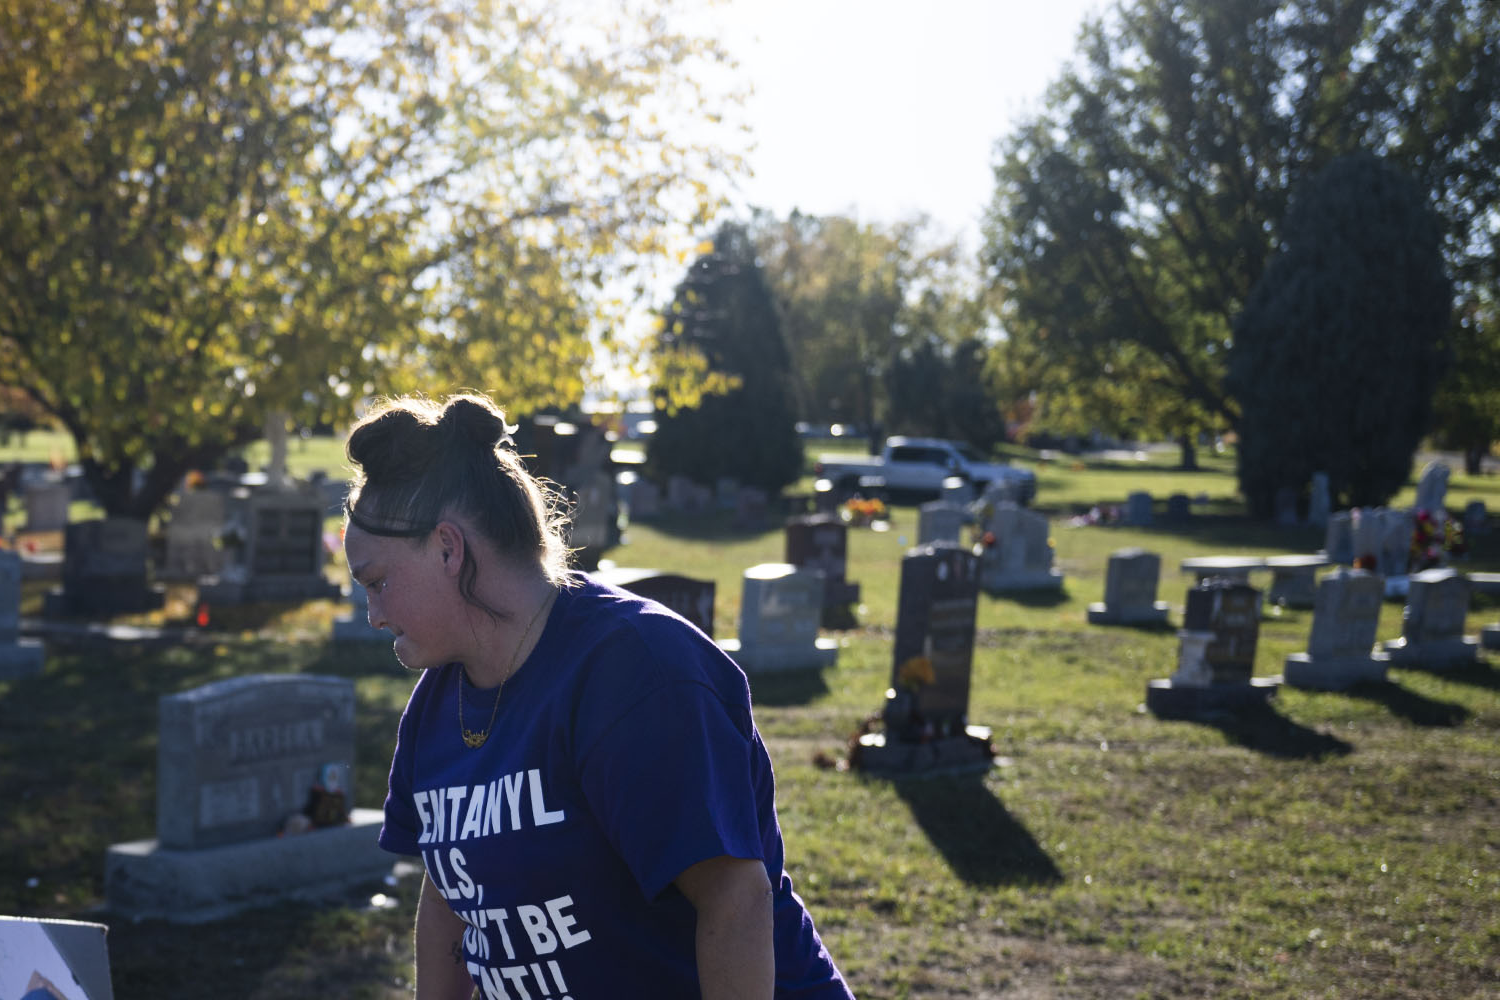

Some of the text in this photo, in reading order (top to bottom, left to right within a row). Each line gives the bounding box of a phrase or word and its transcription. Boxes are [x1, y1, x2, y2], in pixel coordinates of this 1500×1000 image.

[413, 768, 566, 844] ENTANYL
[454, 894, 592, 961] ON'T BE
